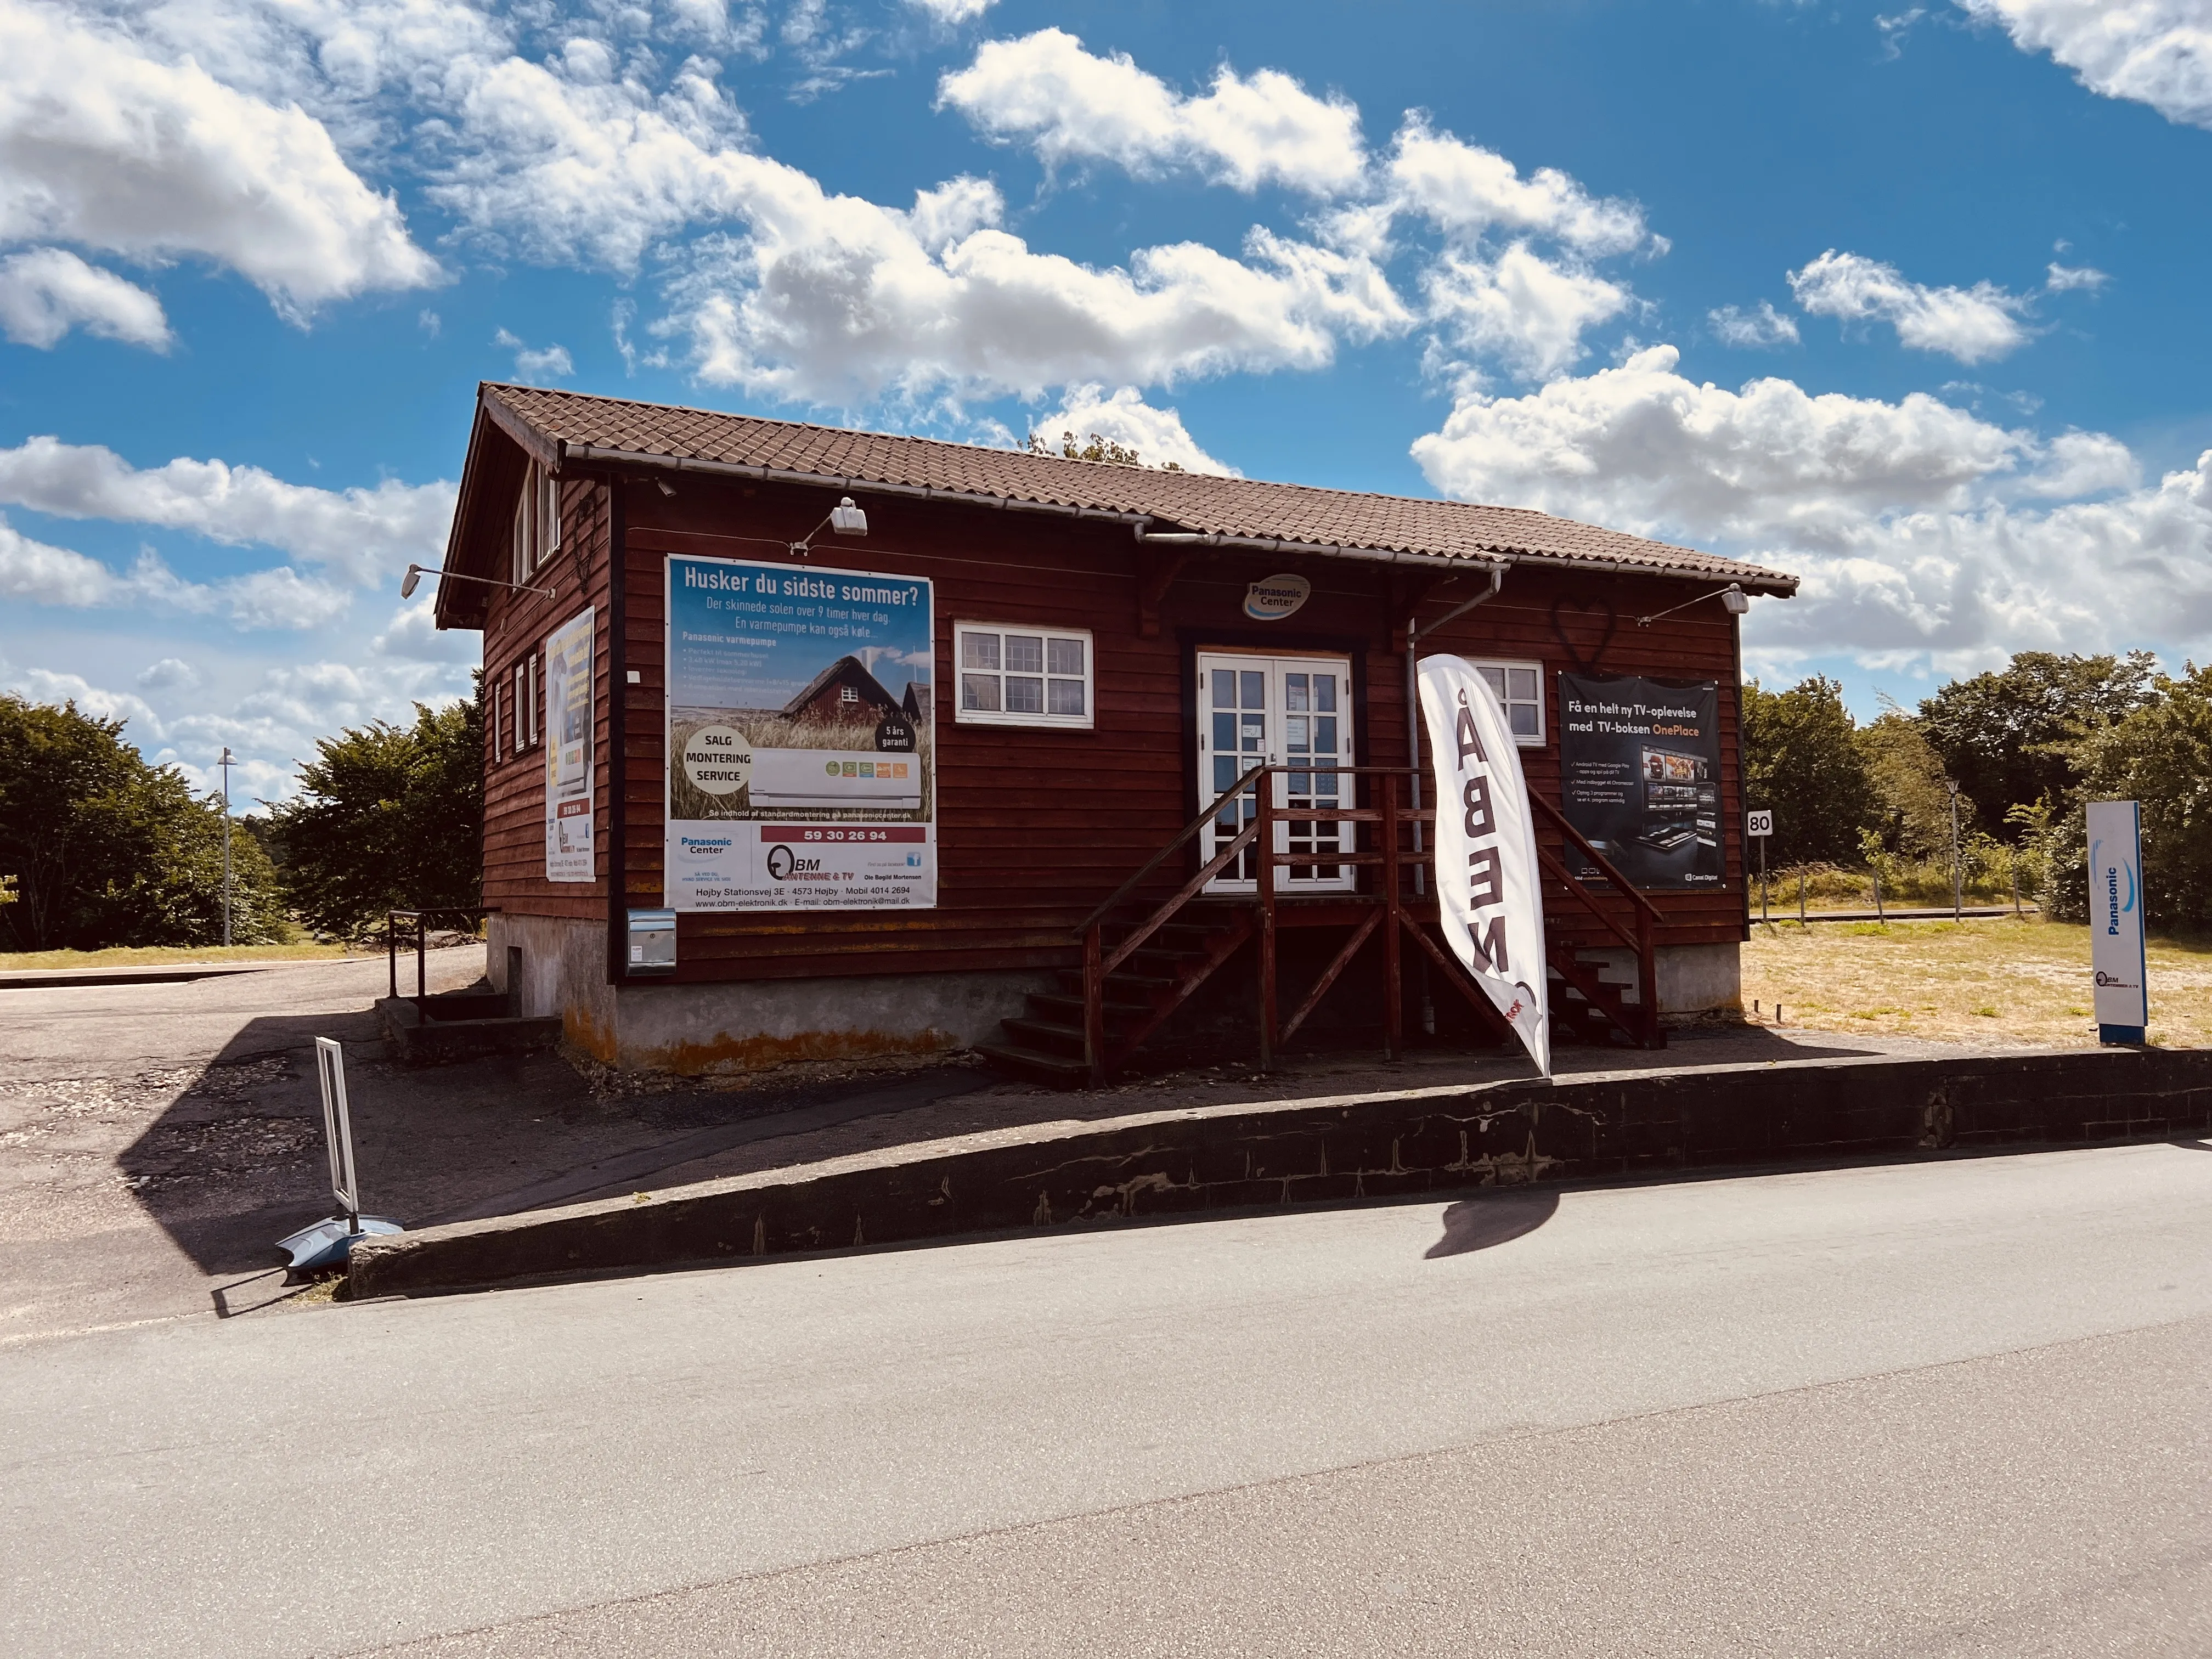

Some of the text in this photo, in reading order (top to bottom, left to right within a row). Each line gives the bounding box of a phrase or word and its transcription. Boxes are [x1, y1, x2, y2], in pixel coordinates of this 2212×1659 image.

[685, 567, 919, 606] Husker du sidste sommer?
[1252, 585, 1302, 598] Panasonic
[1261, 596, 1294, 606] Center
[706, 597, 891, 625] Der skinnede solen over 9 timer hver dag.
[735, 617, 747, 629] En
[749, 620, 808, 635] varmepumpe
[810, 623, 826, 635] kan
[828, 624, 849, 639] også
[682, 631, 777, 648] Panasonic varmepumpe
[717, 668, 747, 676] teknologi
[1568, 699, 1697, 720] Få en helt ny TV-oplevelse
[886, 725, 905, 736] 5 års
[1569, 721, 1700, 737] med TV-boksen OnePlace
[705, 735, 732, 746] SALG
[882, 736, 909, 748] garanti
[686, 752, 751, 764] MONTERING
[697, 770, 741, 782] SERVICE
[760, 810, 831, 819] standardmontering
[832, 811, 841, 819] på
[1750, 816, 1770, 831] 80
[681, 837, 732, 846] Panasonic
[804, 831, 887, 840] 59 30 26 94
[783, 872, 855, 881] ANTENNE & TV
[696, 888, 721, 898] Højby
[724, 888, 771, 896] Stationsvej
[815, 888, 838, 896] Højby
[696, 898, 910, 908] www.obm-elektronik.dk E-mail: obm-elektronik@mail.dk
[2106, 867, 2119, 935] Panasonic
